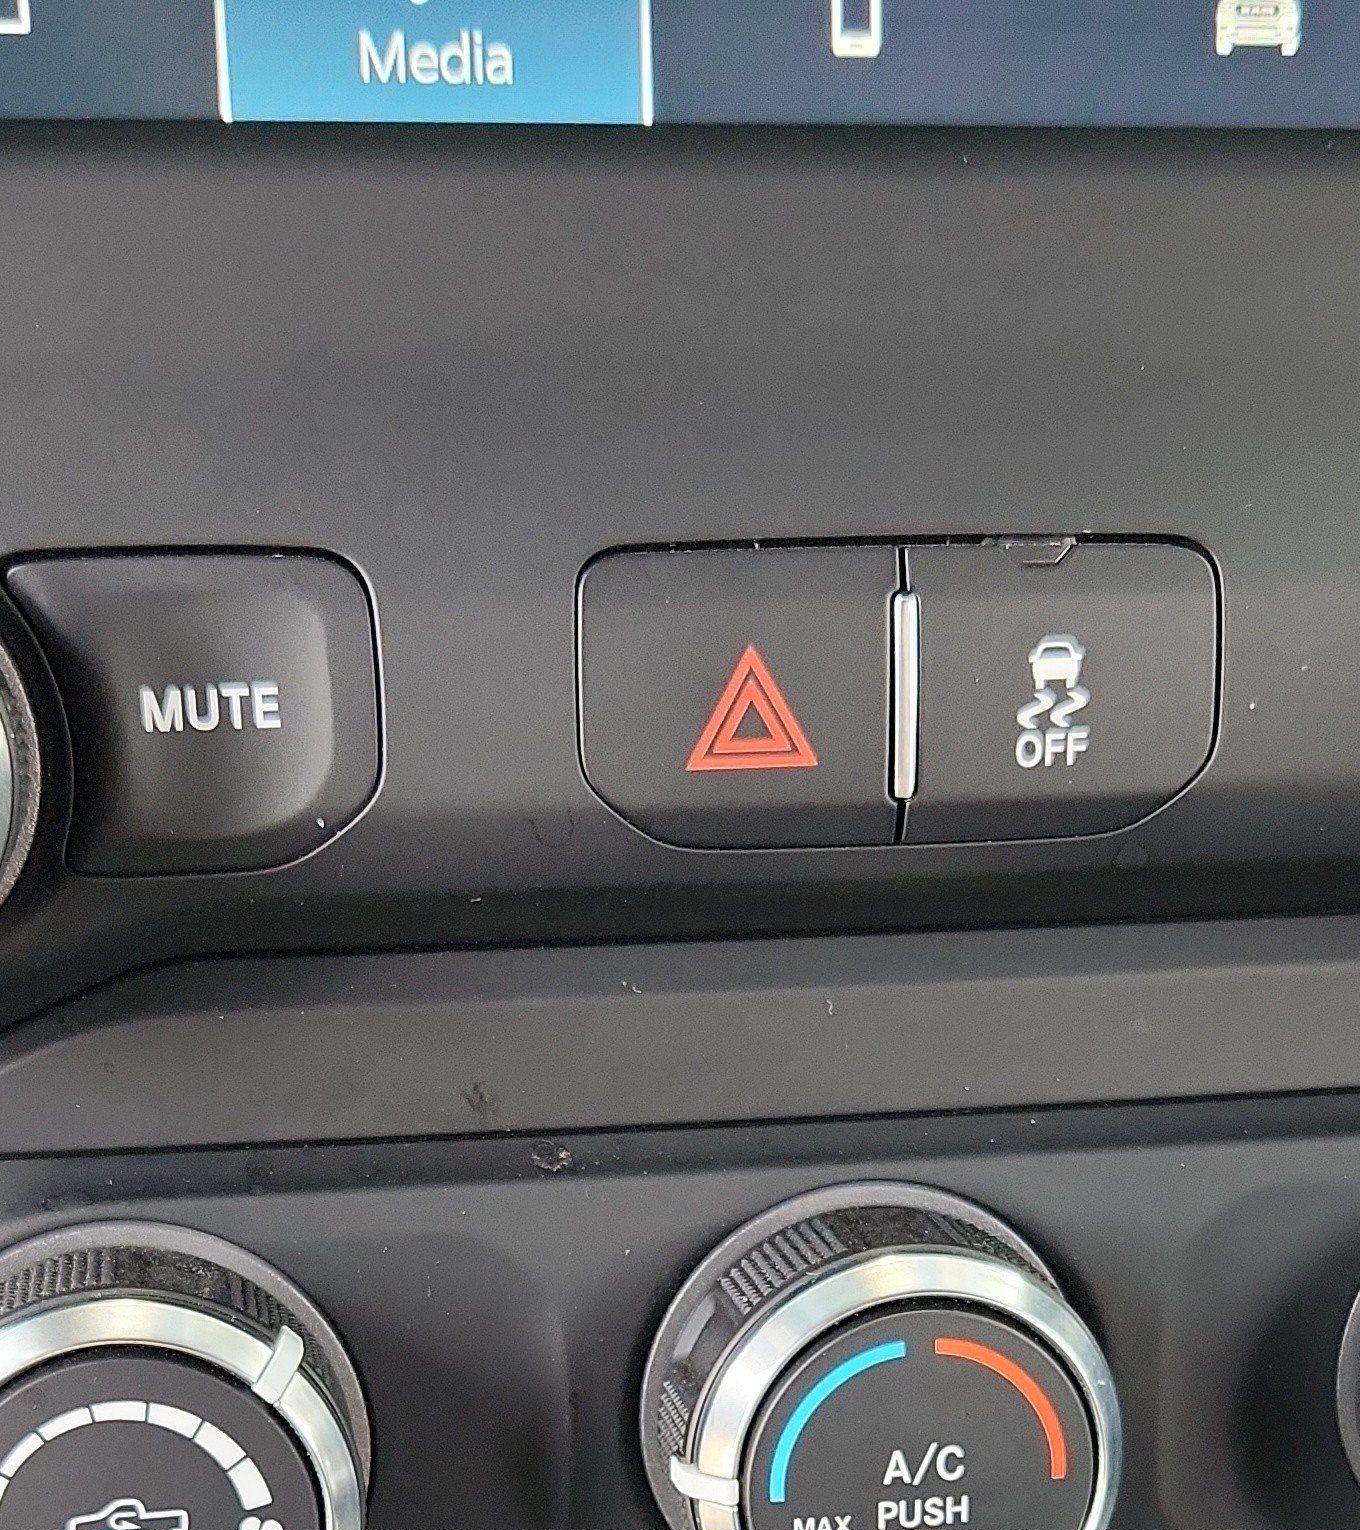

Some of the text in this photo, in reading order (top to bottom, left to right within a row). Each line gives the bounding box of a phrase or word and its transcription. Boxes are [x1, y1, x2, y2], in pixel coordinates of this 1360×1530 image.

[359, 30, 514, 86] Media
[140, 682, 282, 733] MUTE
[1015, 727, 1089, 768] OFF
[883, 1442, 965, 1486] A/C
[877, 1495, 970, 1530] PUSH
